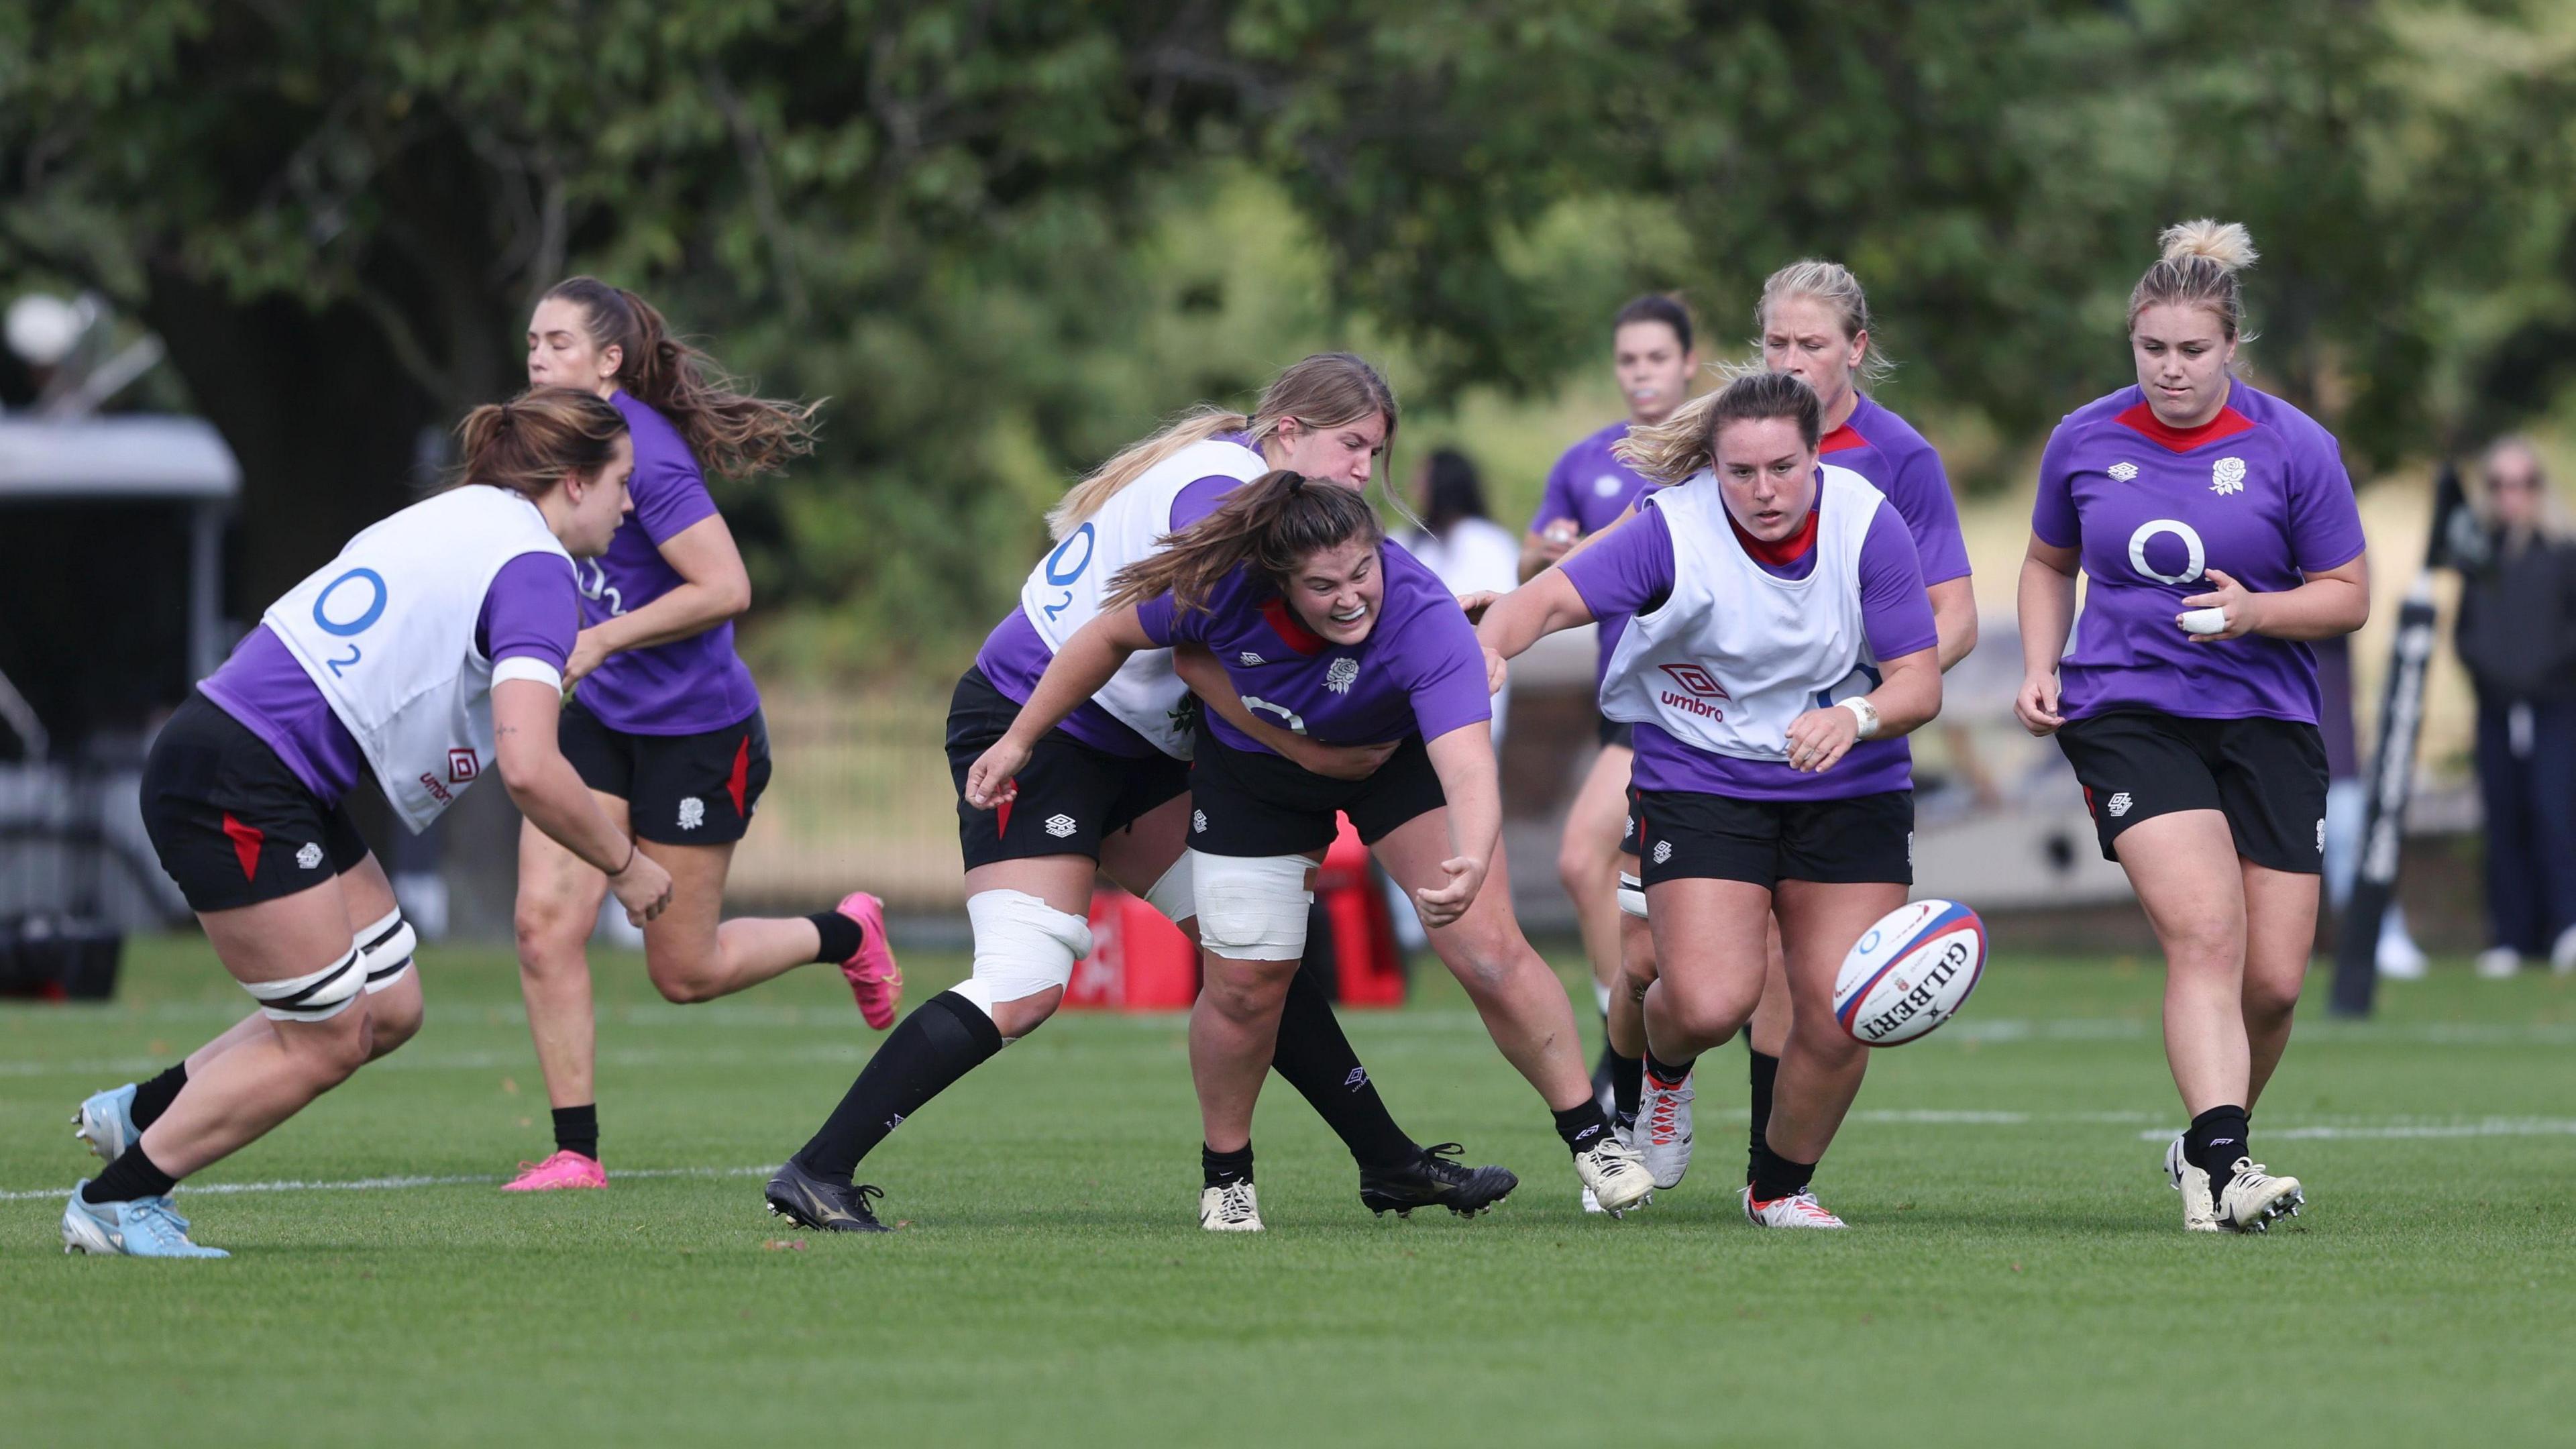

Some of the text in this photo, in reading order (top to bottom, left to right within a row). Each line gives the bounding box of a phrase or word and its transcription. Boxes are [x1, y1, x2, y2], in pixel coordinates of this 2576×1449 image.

[2129, 519, 2206, 585] O
[313, 568, 387, 678] O2
[1661, 690, 1723, 722] umbro
[419, 772, 453, 806] umbr
[1862, 942, 1968, 1040] GILBERT
